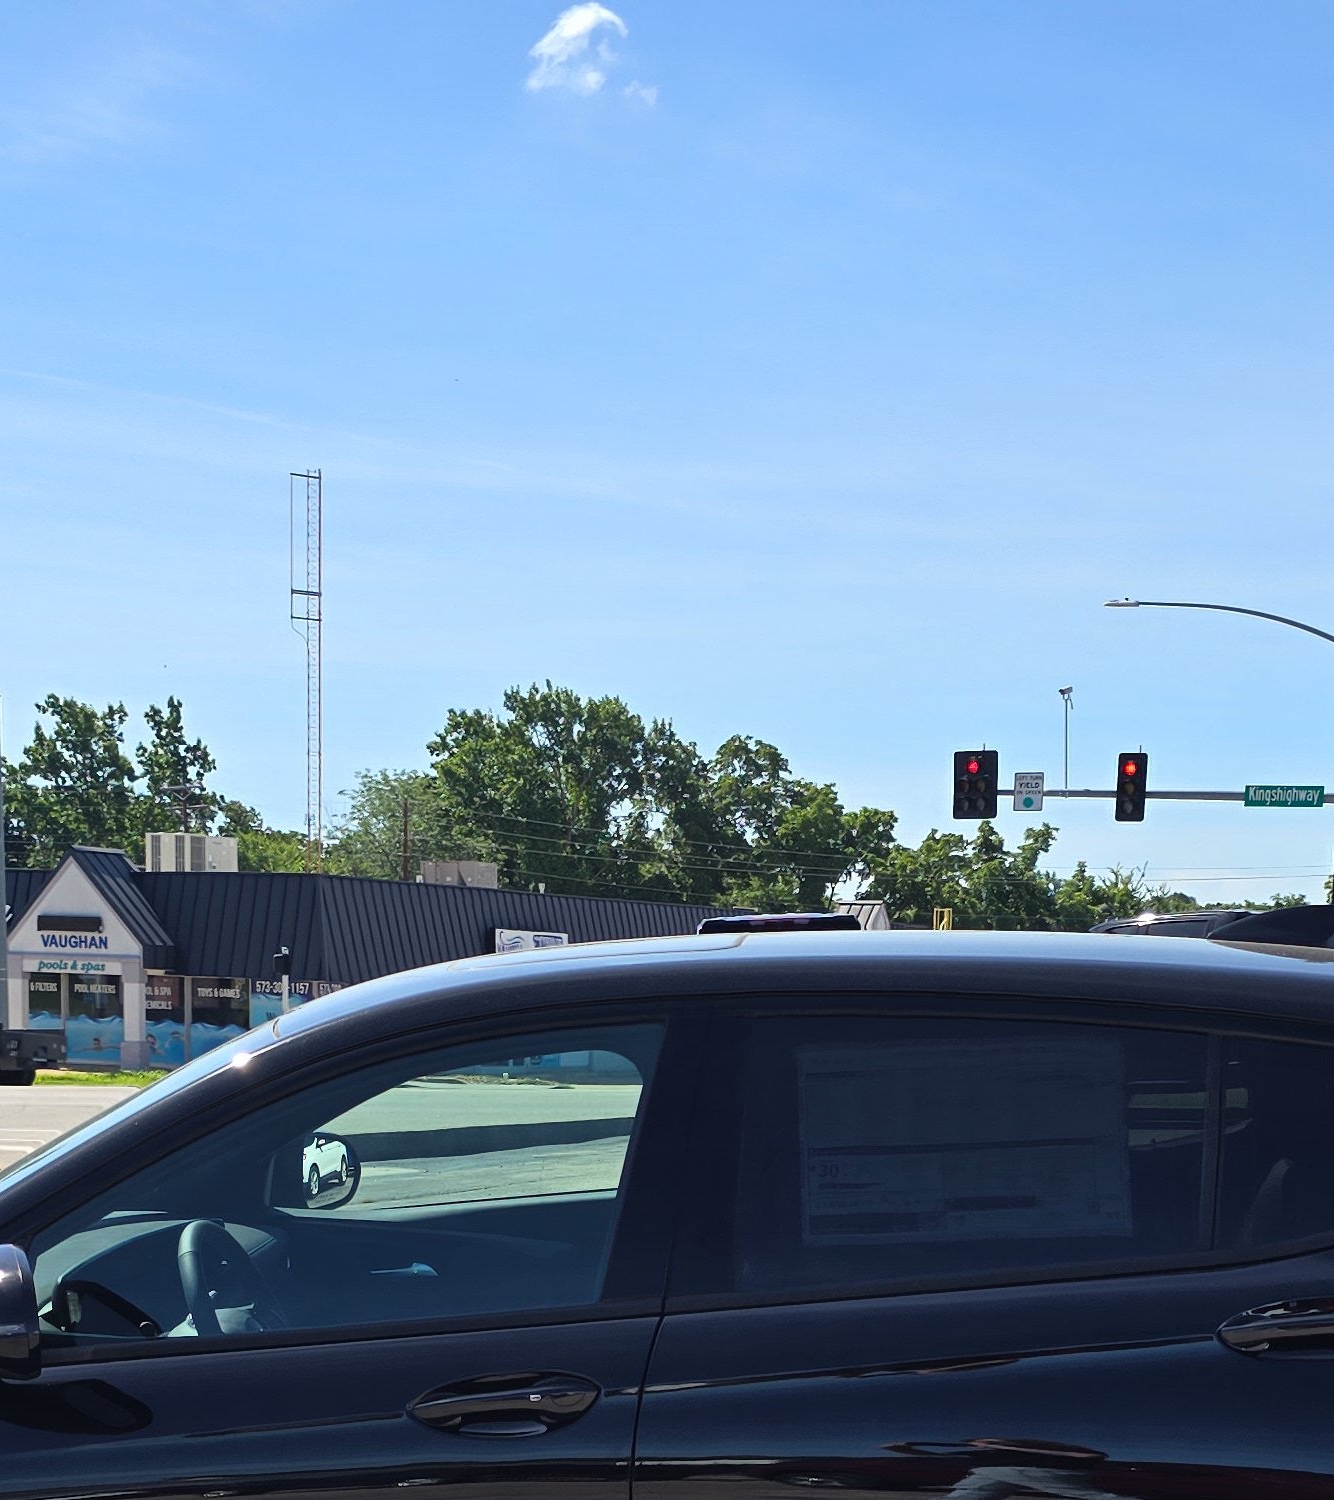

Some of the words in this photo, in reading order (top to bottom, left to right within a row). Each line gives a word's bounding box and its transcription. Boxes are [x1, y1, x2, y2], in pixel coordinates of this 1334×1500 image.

[1249, 786, 1320, 805] Kingshighway
[41, 934, 108, 949] VAUGHAN
[38, 960, 68, 972] pools
[70, 962, 78, 971] &
[80, 962, 106, 973] spas
[35, 982, 58, 992] FILTERS
[197, 988, 213, 997] TOYS
[256, 980, 310, 994] 573-30-1157
